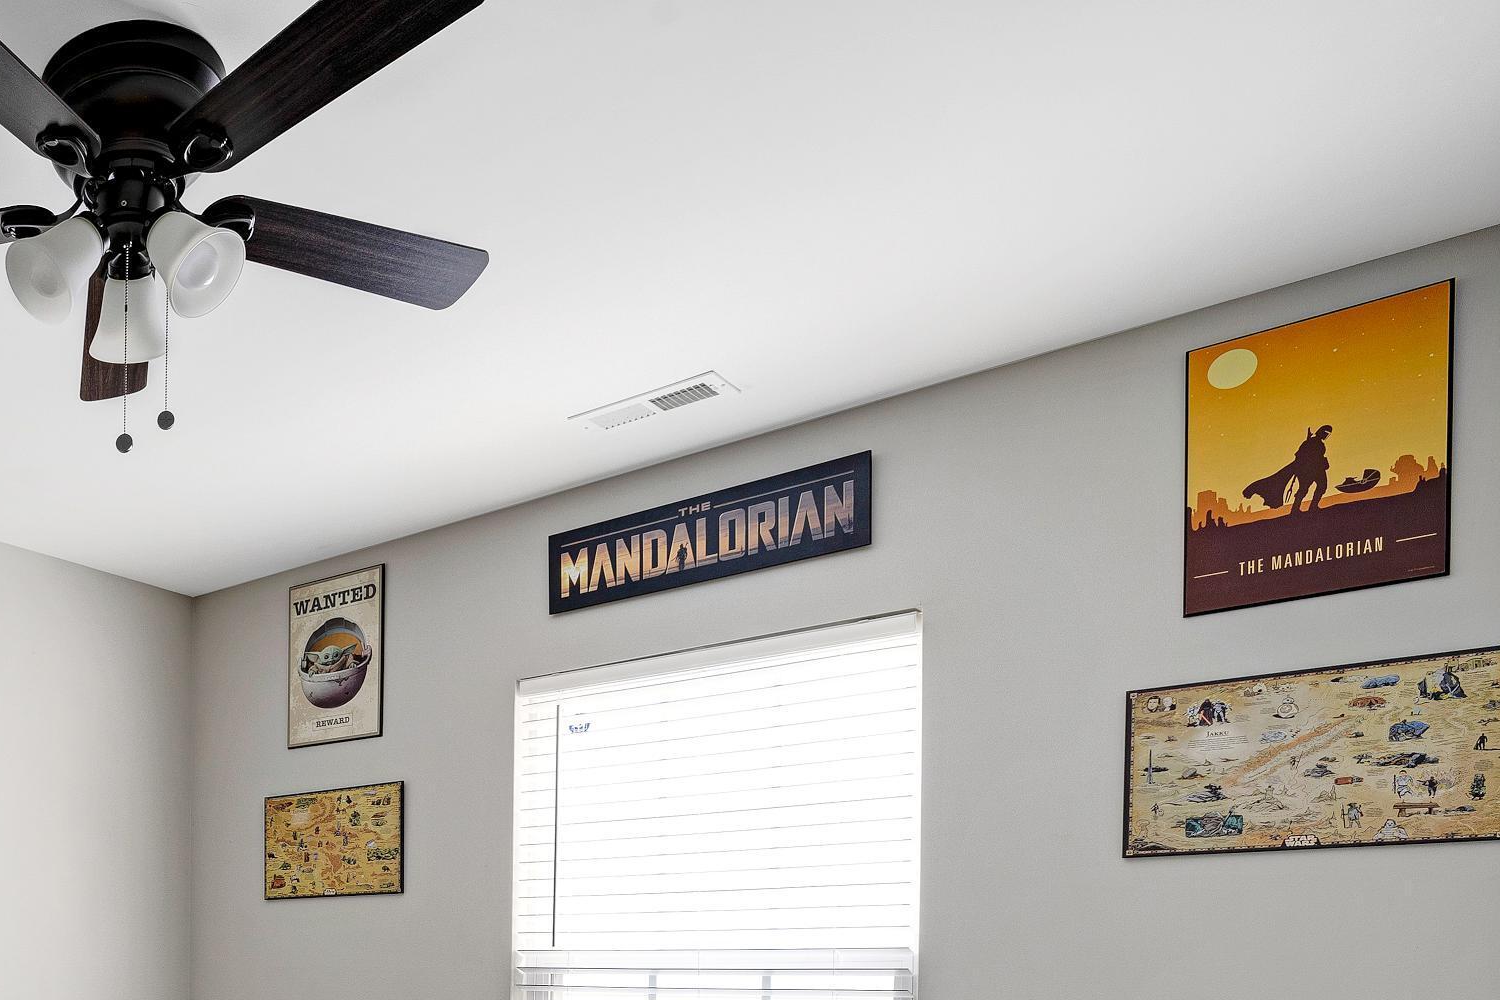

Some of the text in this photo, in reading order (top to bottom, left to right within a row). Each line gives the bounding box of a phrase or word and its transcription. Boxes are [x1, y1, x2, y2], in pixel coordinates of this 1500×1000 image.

[678, 501, 711, 517] THE
[560, 479, 854, 599] MANDALORIAN
[1239, 536, 1384, 577] THE MANDALORIAN
[293, 583, 377, 617] WANTED
[315, 715, 351, 728] REWARD
